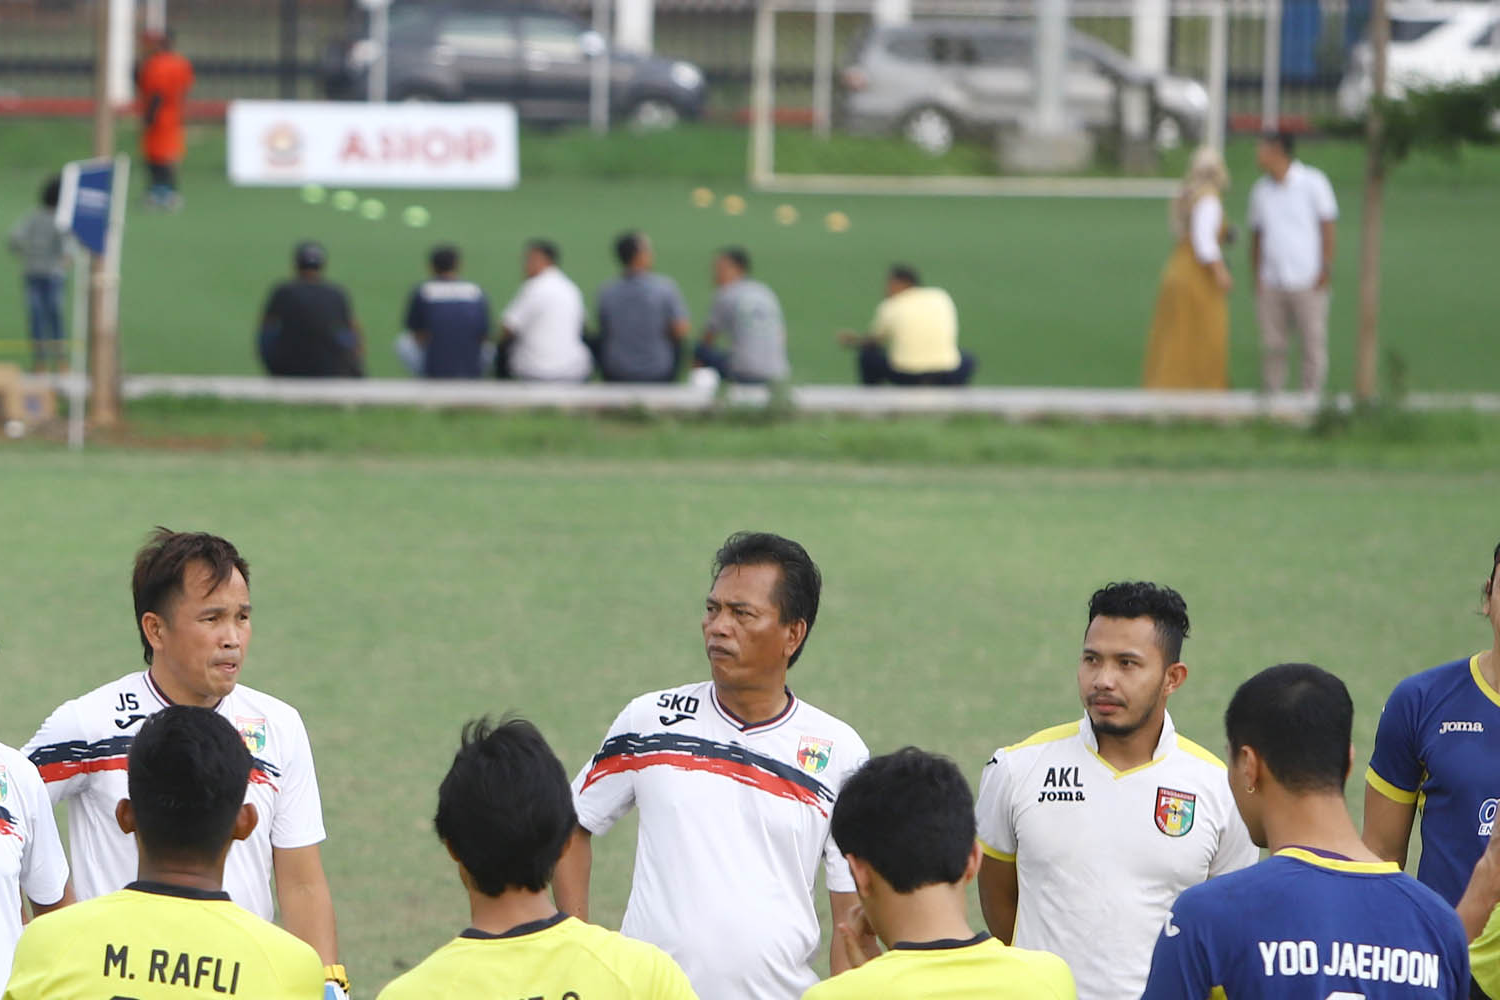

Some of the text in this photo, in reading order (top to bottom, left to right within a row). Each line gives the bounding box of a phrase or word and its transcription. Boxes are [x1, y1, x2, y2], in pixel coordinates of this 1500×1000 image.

[115, 693, 139, 711] JS
[657, 693, 700, 714] SKD
[1043, 767, 1084, 787] AKL
[103, 944, 240, 995] M. RAFLI
[1258, 941, 1439, 988] YOO JAEHOON
